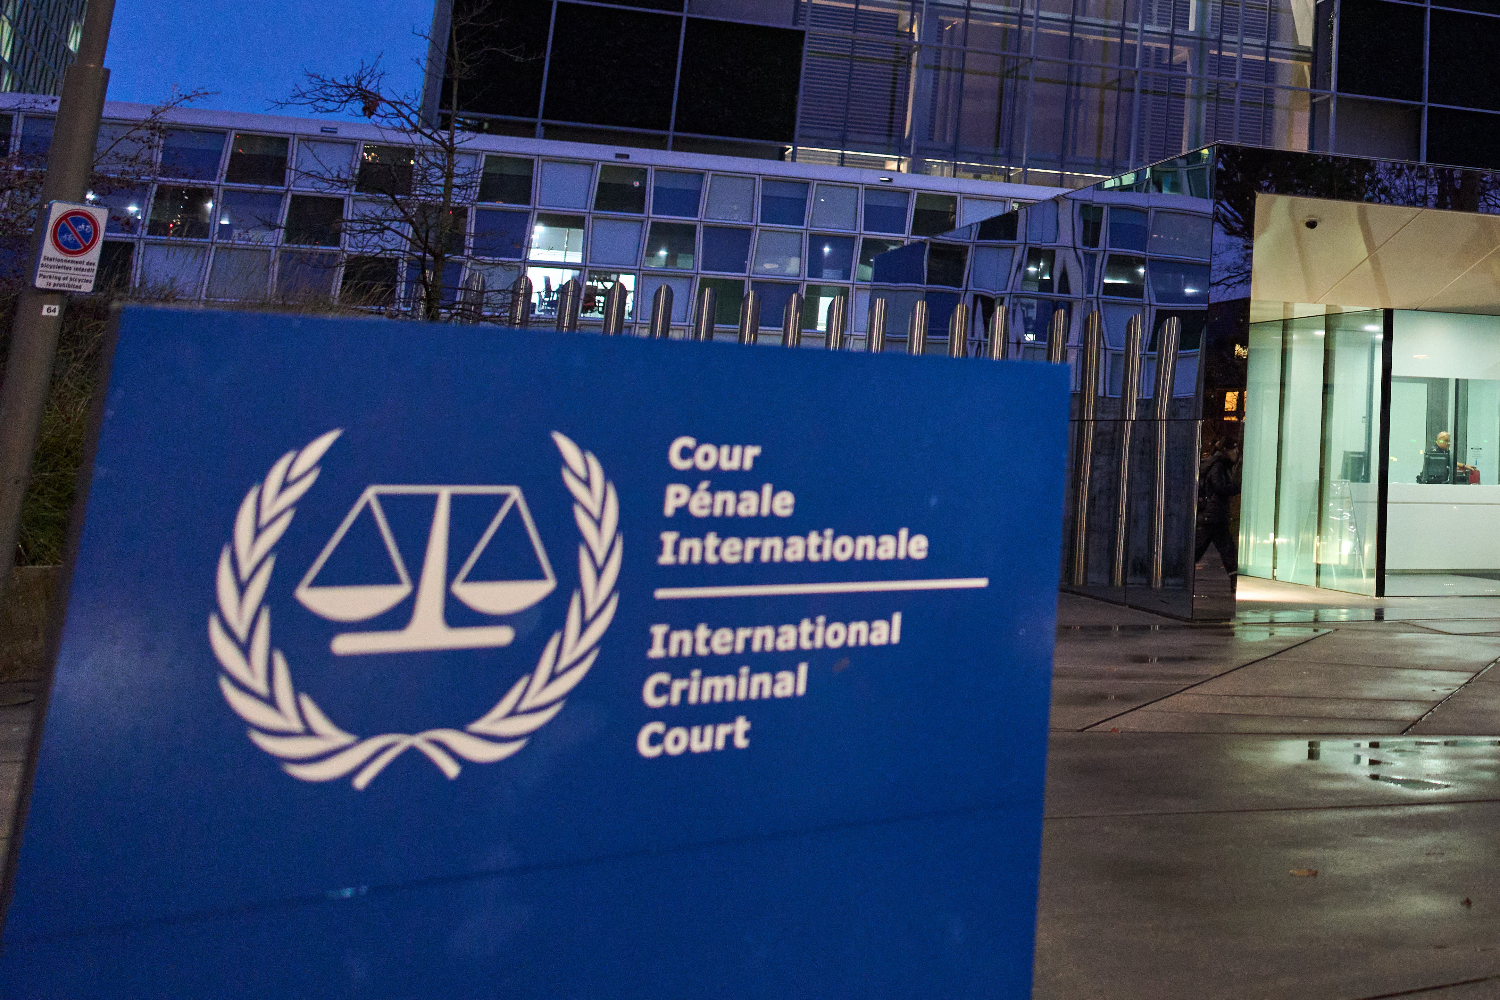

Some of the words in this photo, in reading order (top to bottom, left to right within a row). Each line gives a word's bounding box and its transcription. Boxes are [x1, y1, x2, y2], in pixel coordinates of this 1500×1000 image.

[38, 273, 61, 281] Parking
[40, 262, 72, 271] bicyclettes
[43, 255, 85, 265] Stationnement
[669, 436, 761, 470] Cour
[664, 481, 795, 517] Pénale
[658, 528, 928, 565] Internationale
[647, 612, 901, 658] International
[643, 662, 808, 708] Criminal
[637, 716, 750, 757] Court
